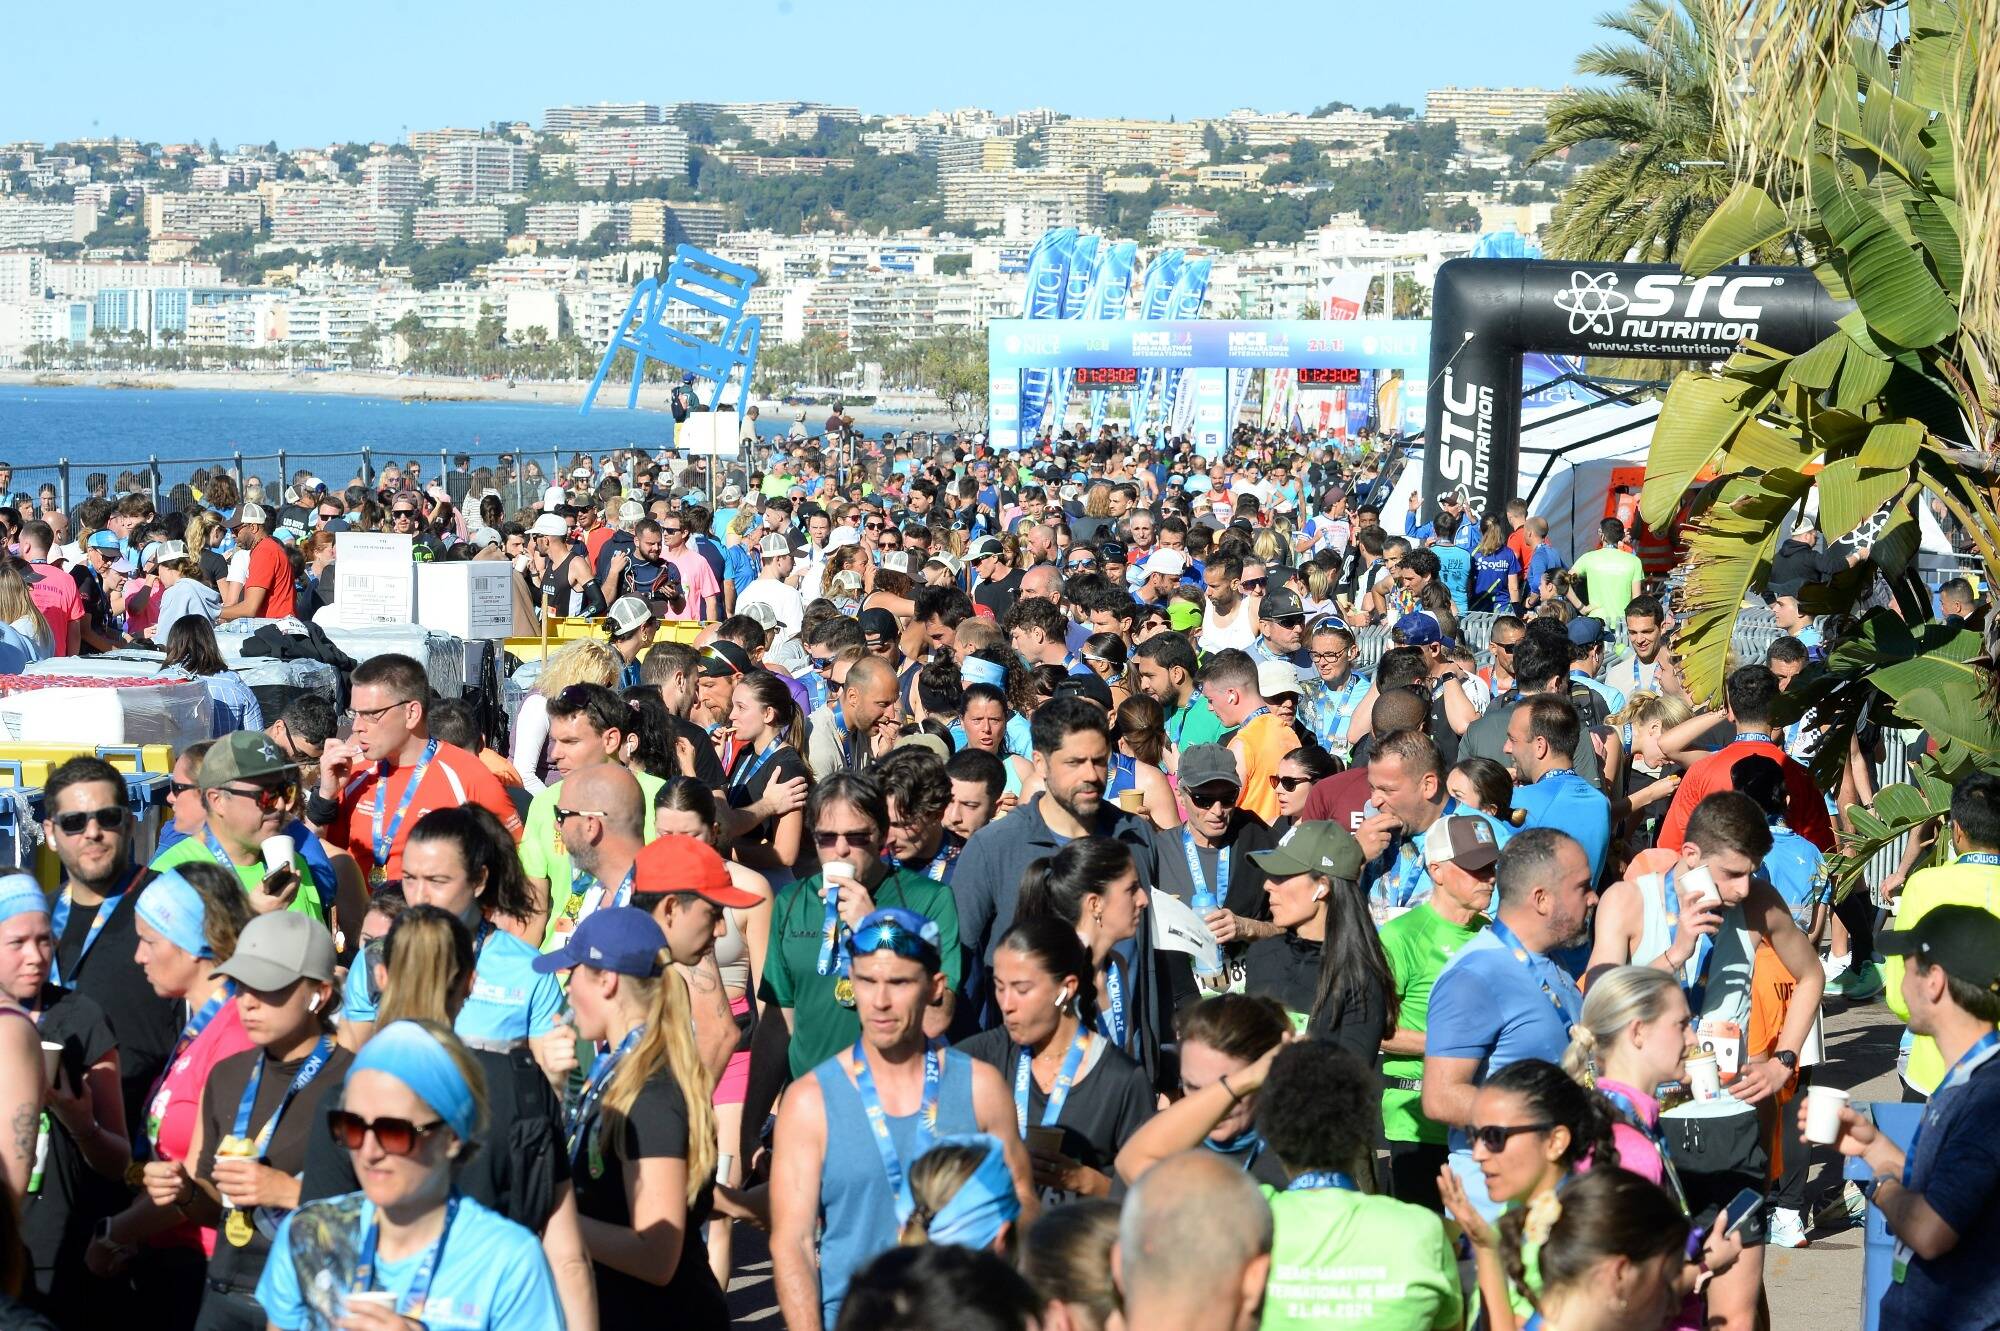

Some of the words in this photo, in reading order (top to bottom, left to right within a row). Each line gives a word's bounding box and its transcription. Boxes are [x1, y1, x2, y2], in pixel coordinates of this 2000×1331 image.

[1133, 332, 1170, 346] NICE
[1228, 332, 1267, 346] NICE
[1621, 319, 1759, 341] NUTRITION
[1473, 385, 1494, 492] NUTRITION
[1107, 973, 1122, 1015] EDITION
